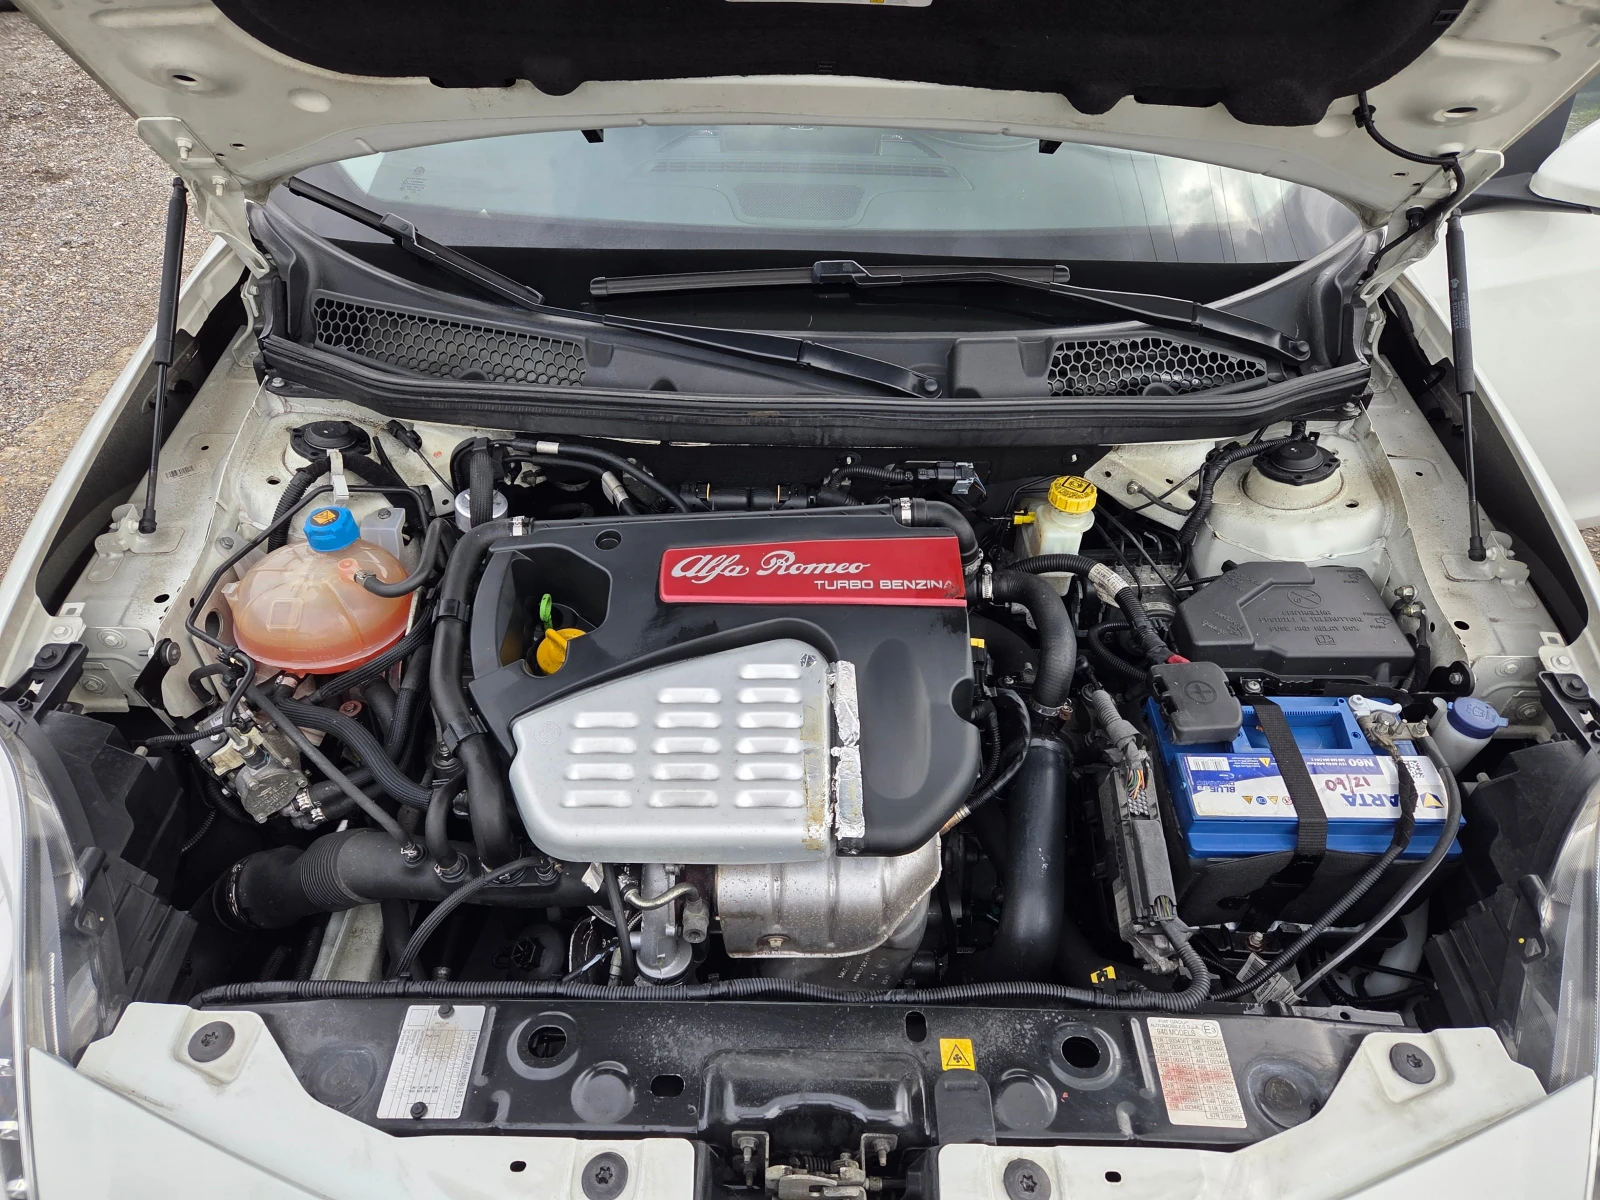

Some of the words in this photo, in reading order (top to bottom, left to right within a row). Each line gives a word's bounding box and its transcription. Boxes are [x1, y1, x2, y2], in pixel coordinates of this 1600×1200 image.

[672, 554, 748, 583] Alfa
[757, 550, 871, 575] Romeo
[814, 580, 873, 590] TURBO
[1348, 758, 1374, 767] N60
[1340, 794, 1417, 807] ARTA
